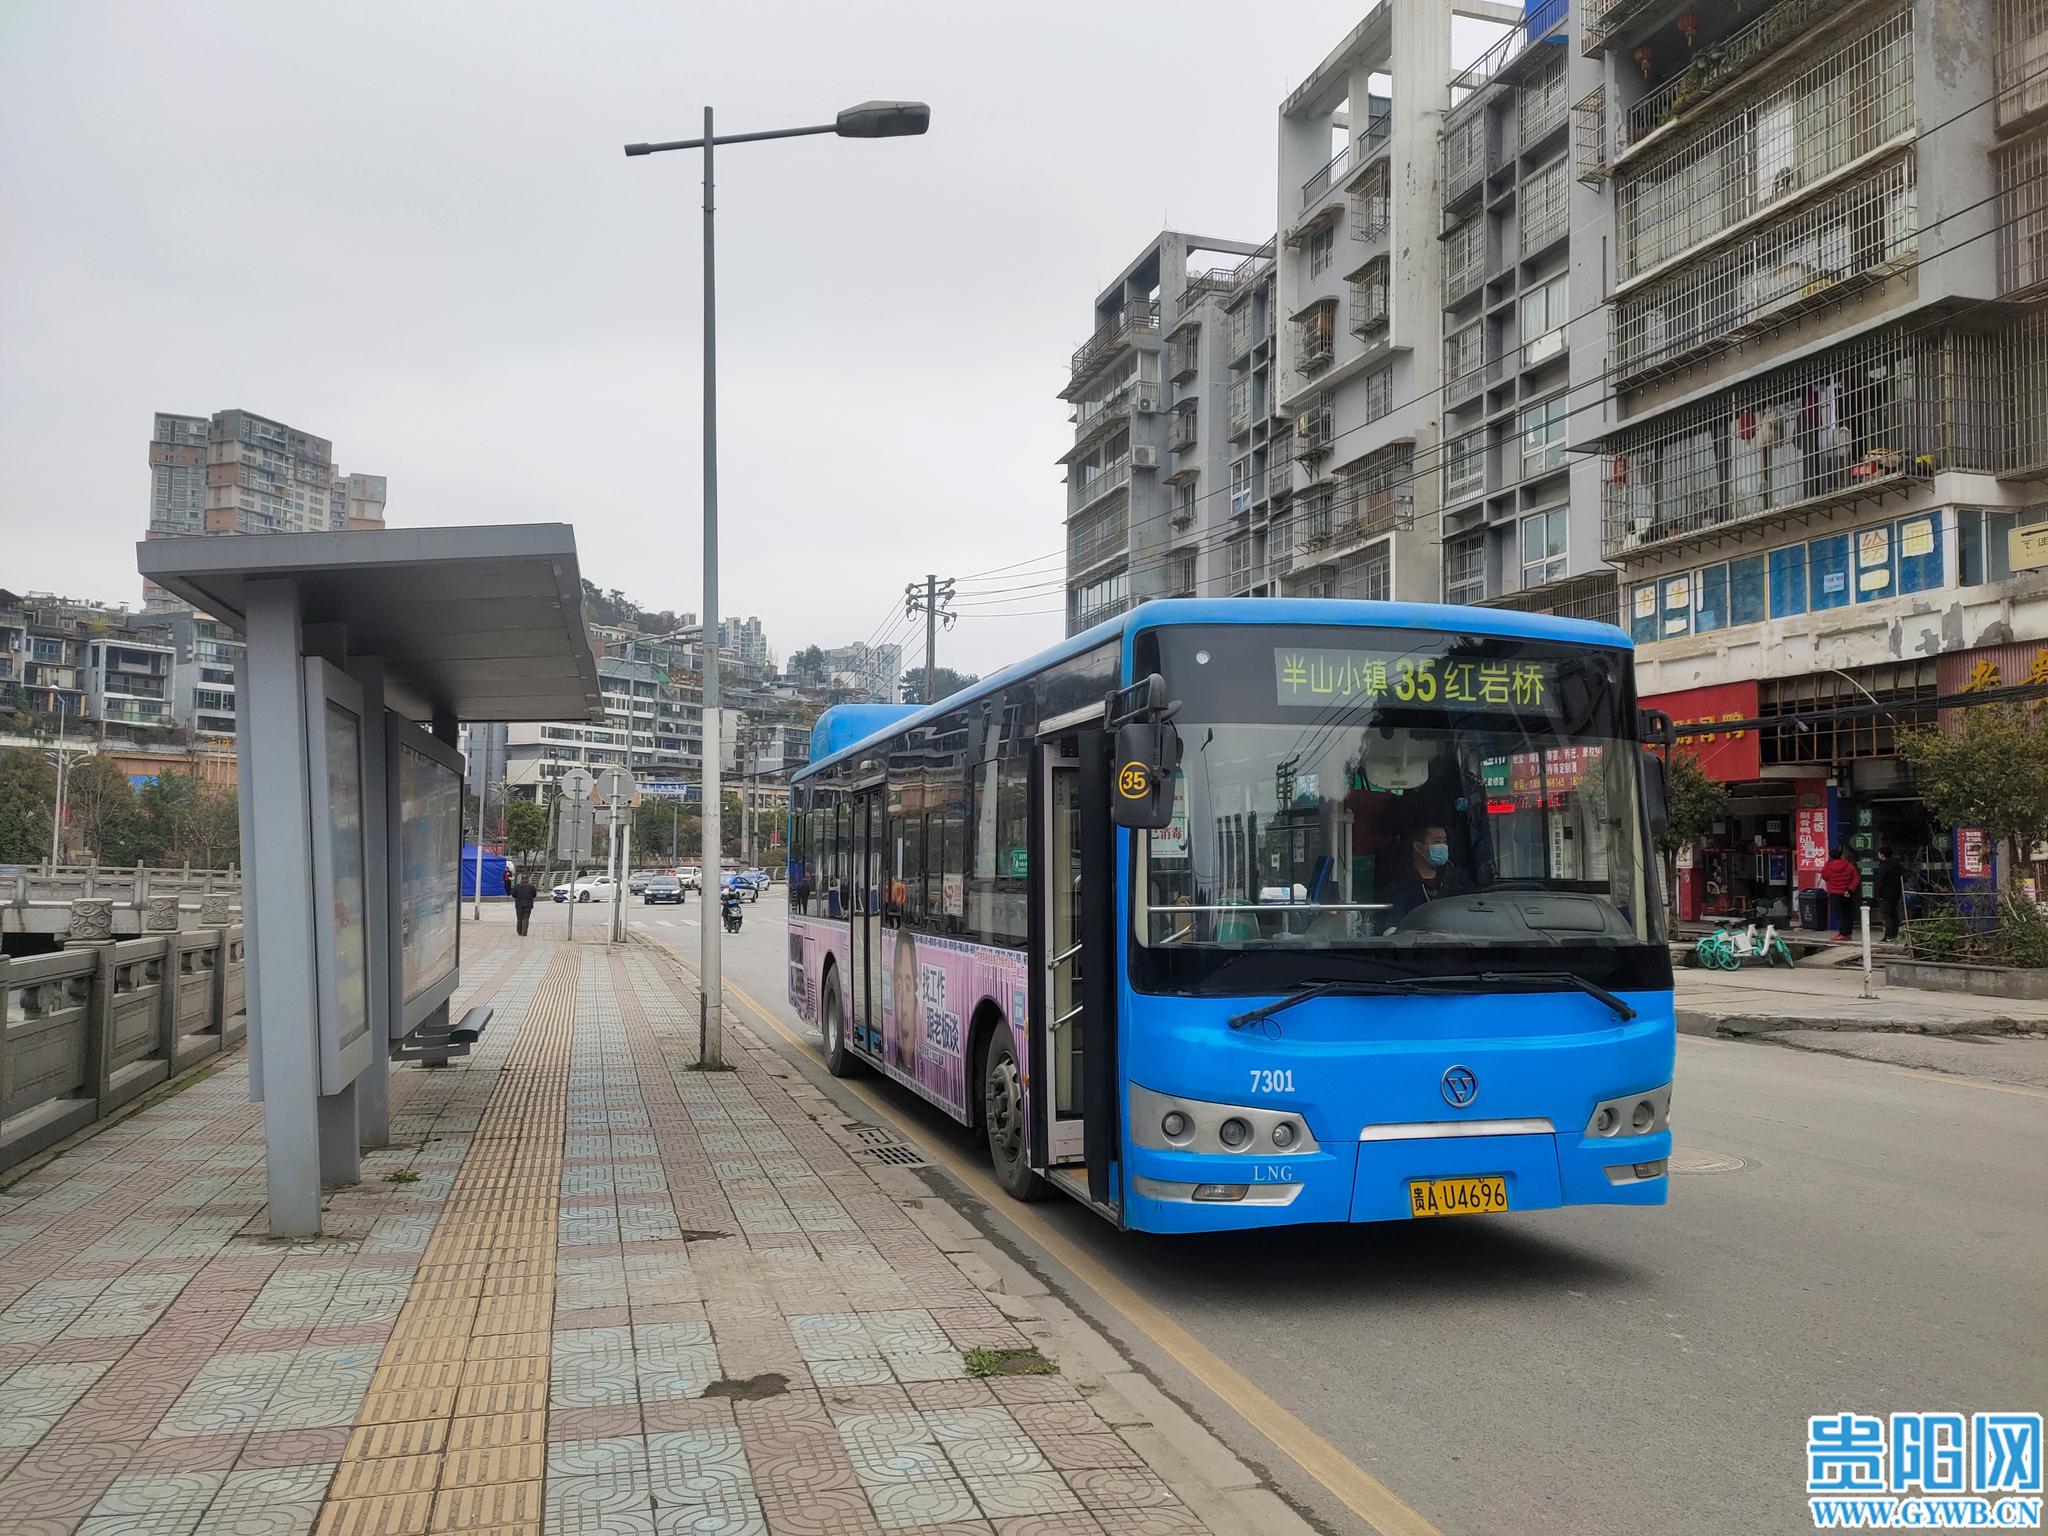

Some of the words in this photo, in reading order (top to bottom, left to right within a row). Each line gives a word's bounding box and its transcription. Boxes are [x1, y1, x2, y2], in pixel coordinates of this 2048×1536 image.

[1282, 653, 1388, 697] 半山小镇
[1395, 658, 1438, 702] 35
[1444, 661, 1545, 706] 红岩桥
[1122, 771, 1146, 790] 35
[921, 964, 946, 1008] 找工作
[926, 1005, 960, 1055] 跟老板谈
[1250, 1069, 1296, 1094] 7301
[1253, 1165, 1293, 1182] LNG
